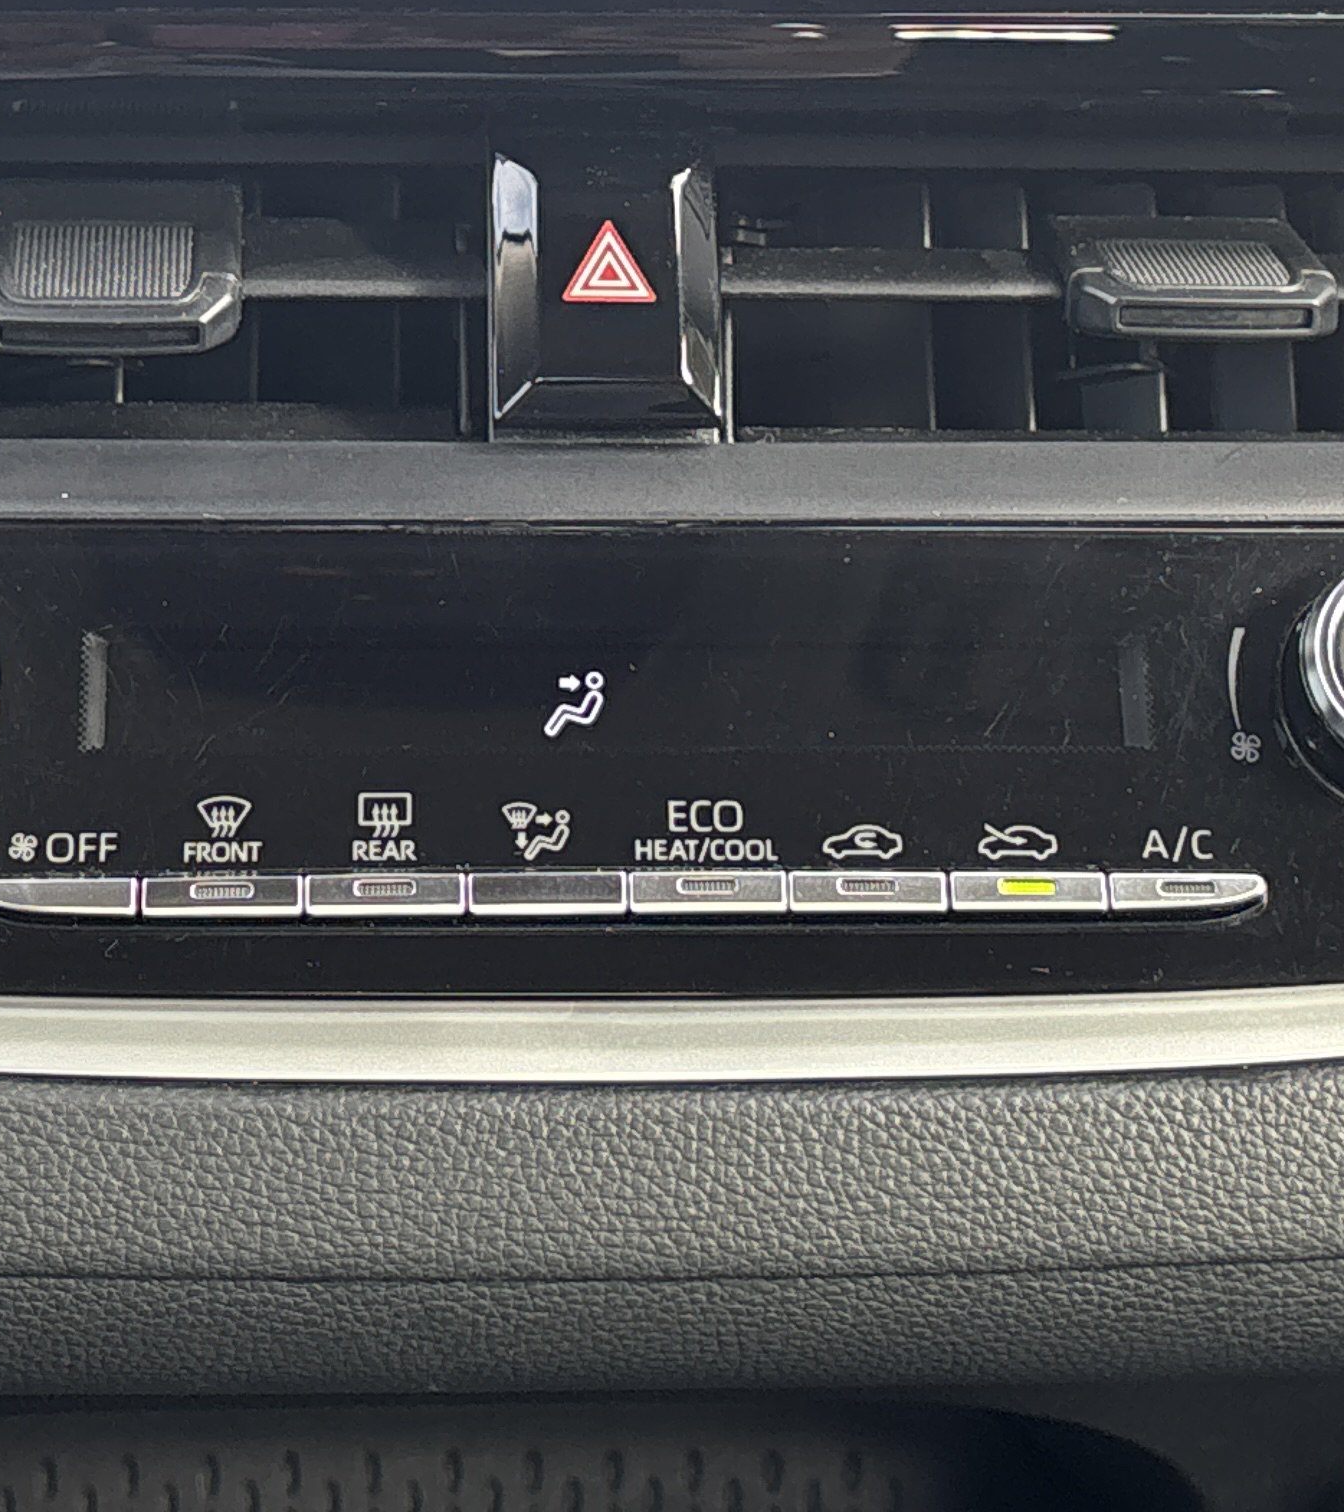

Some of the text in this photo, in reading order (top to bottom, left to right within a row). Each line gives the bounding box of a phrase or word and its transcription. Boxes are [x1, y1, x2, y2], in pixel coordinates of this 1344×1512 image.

[667, 800, 745, 833] ECO
[45, 832, 118, 864] OFF
[183, 841, 262, 864] FRONT
[352, 840, 416, 863] REAR
[634, 839, 779, 863] HEAT/COOL
[1142, 826, 1214, 861] A/C
